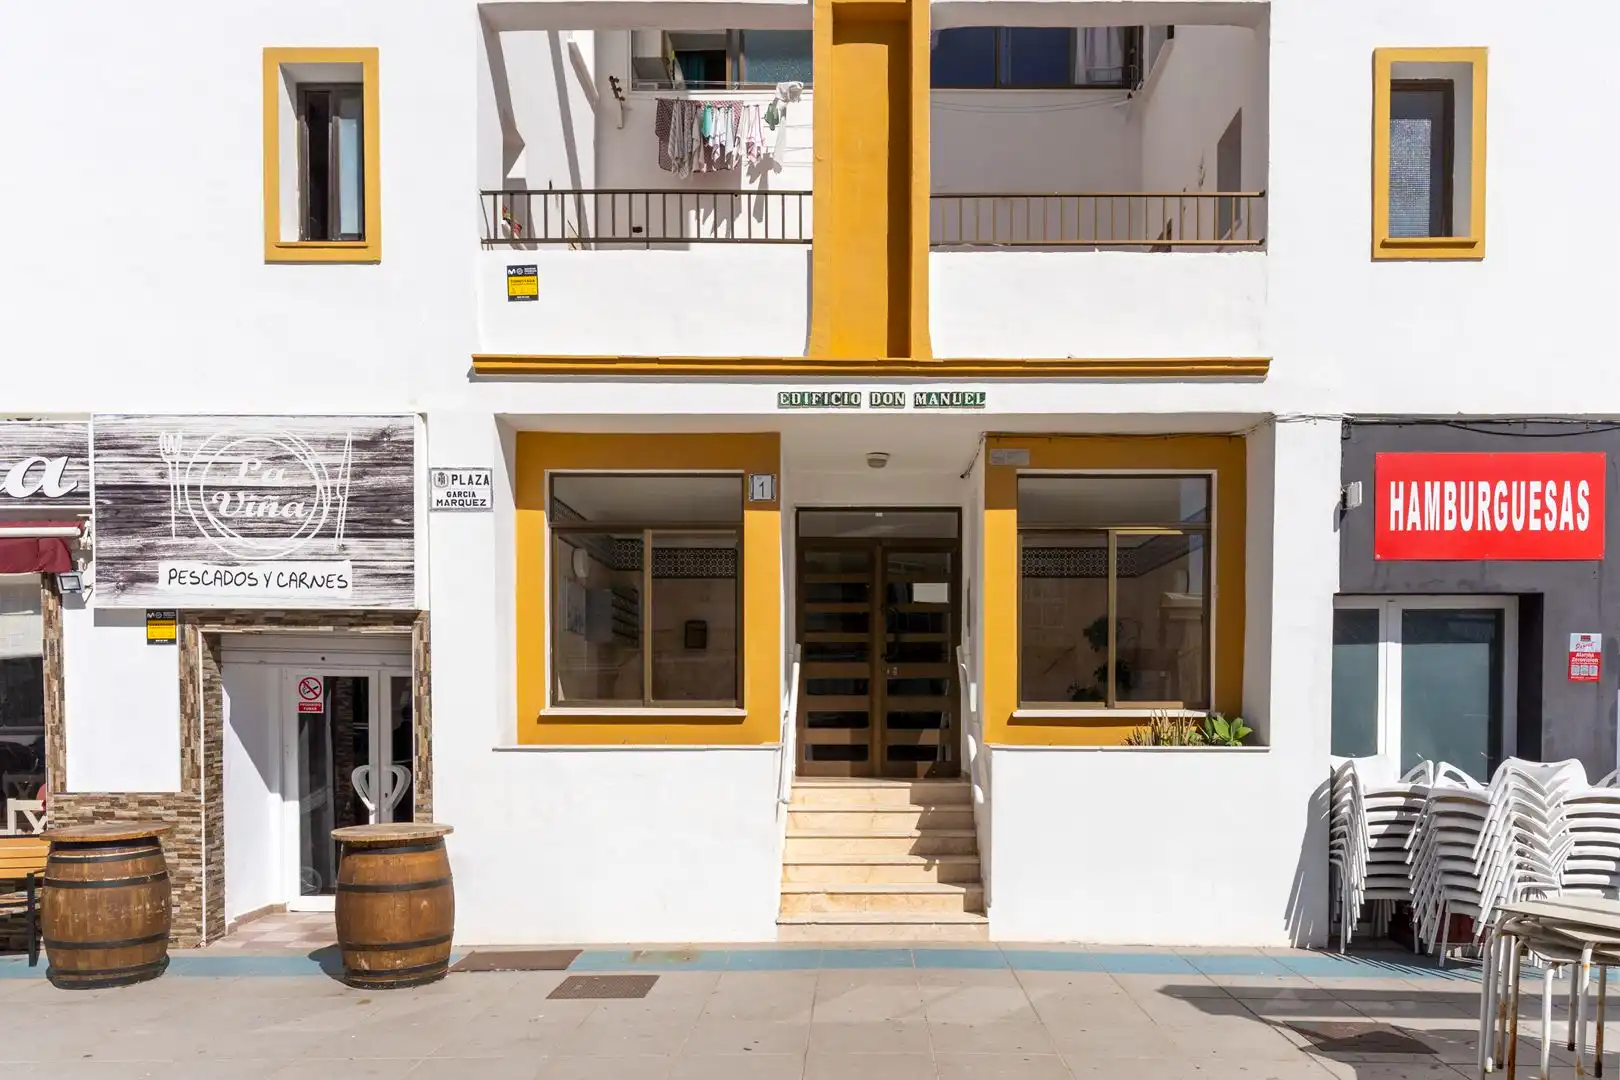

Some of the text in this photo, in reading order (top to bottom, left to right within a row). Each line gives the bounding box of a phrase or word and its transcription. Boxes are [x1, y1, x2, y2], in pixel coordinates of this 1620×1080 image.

[779, 392, 986, 406] EDIFICIO DON MANUEL
[229, 457, 286, 484] La
[451, 474, 490, 486] PLAZA
[759, 481, 765, 498] 1
[211, 491, 308, 518] Viña
[436, 498, 487, 507] MARQUEZ
[1389, 480, 1590, 532] HAMBURGUESAS
[168, 568, 349, 589] PESCADOS Y CARNES
